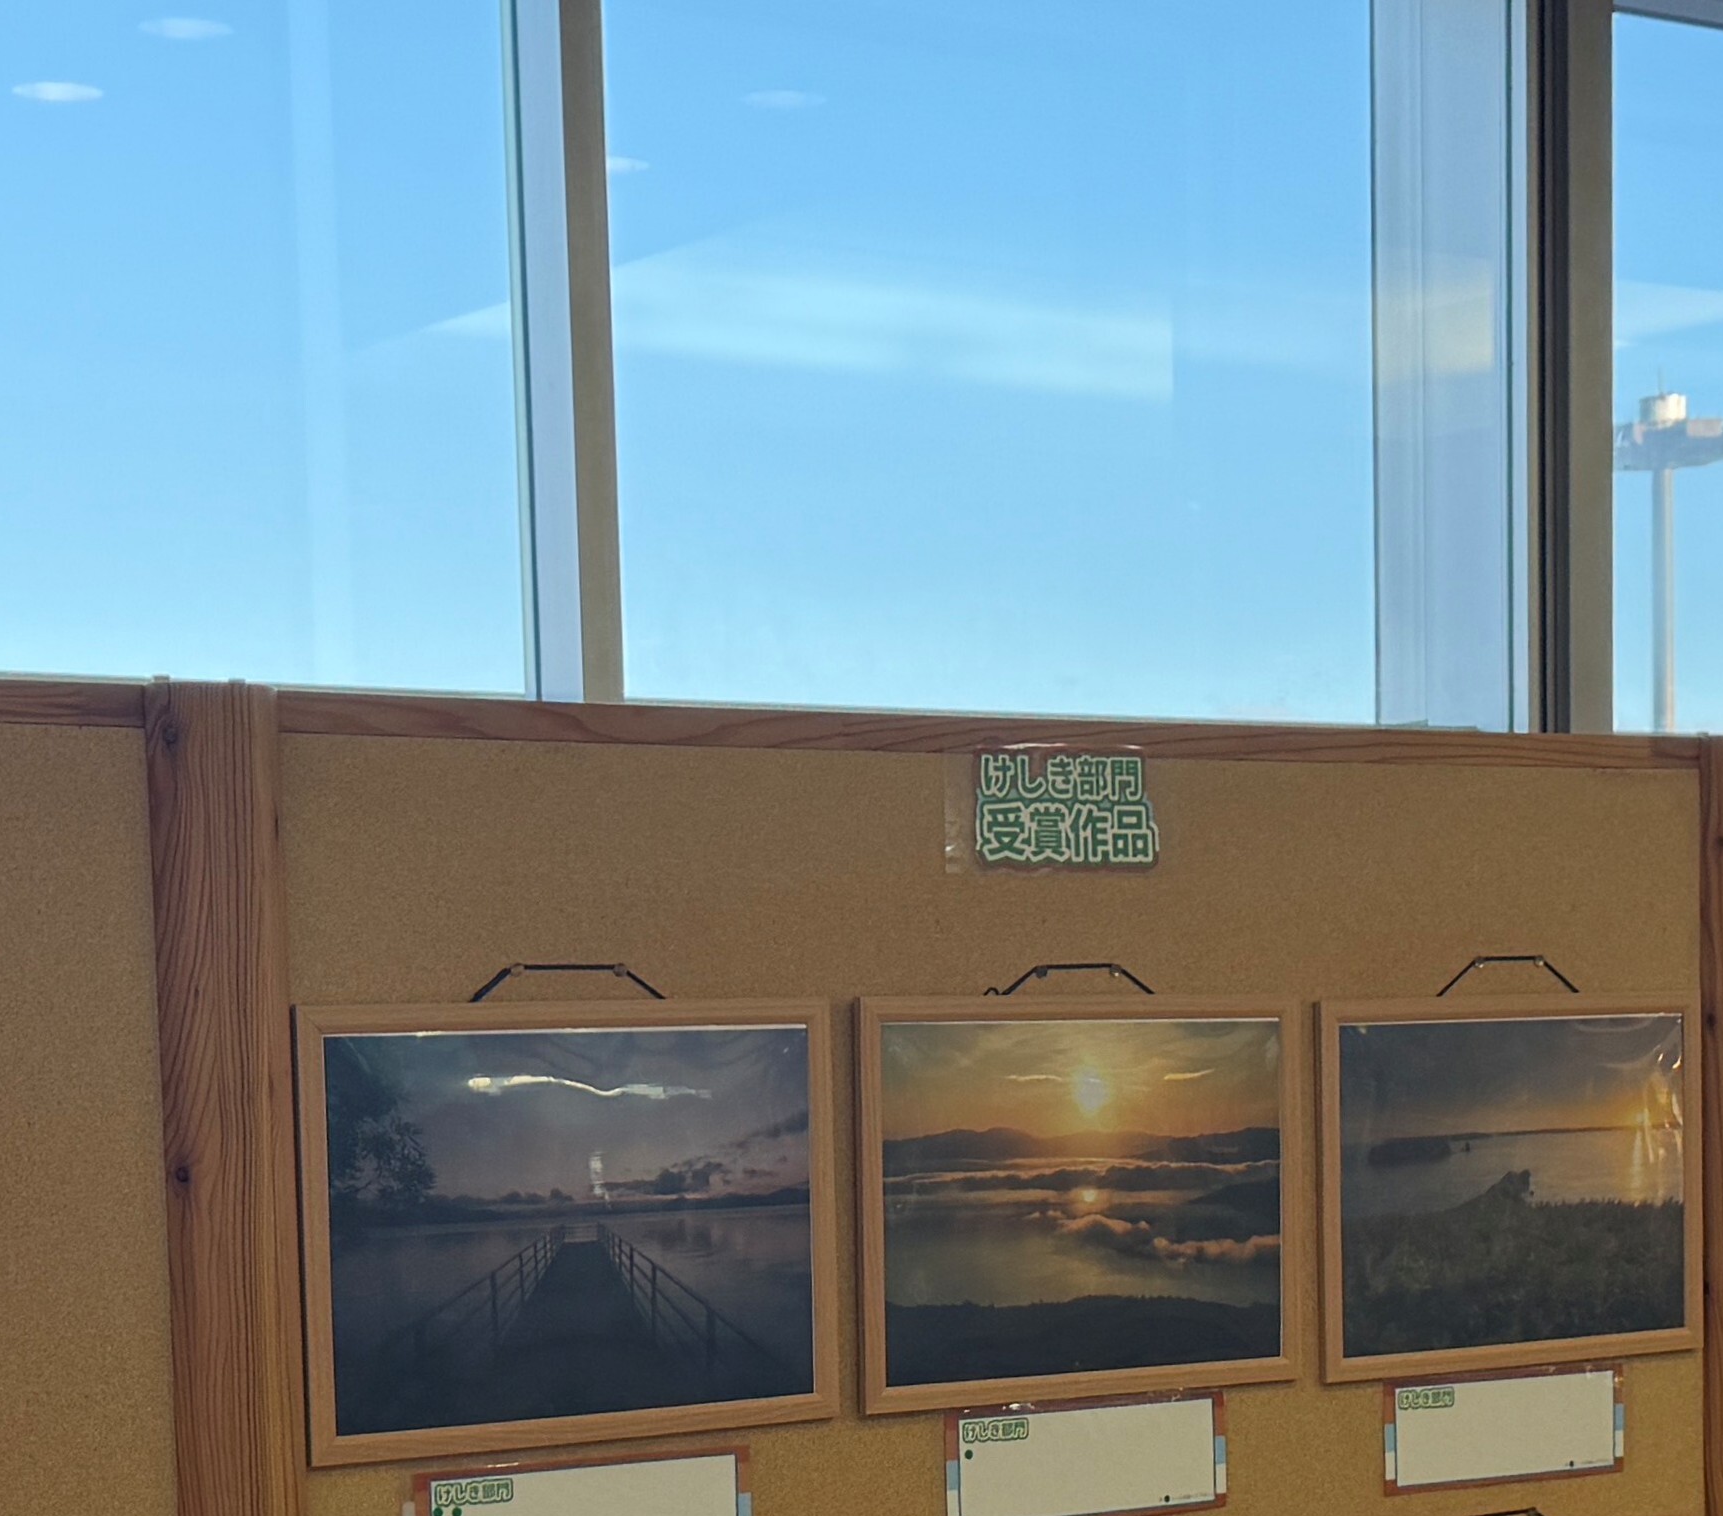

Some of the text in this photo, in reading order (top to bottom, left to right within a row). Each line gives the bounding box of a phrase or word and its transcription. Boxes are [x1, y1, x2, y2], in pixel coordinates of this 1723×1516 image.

[980, 755, 1144, 801] けしき部門
[983, 801, 1155, 863] 受賞作品
[435, 1478, 514, 1507] けしき部門
